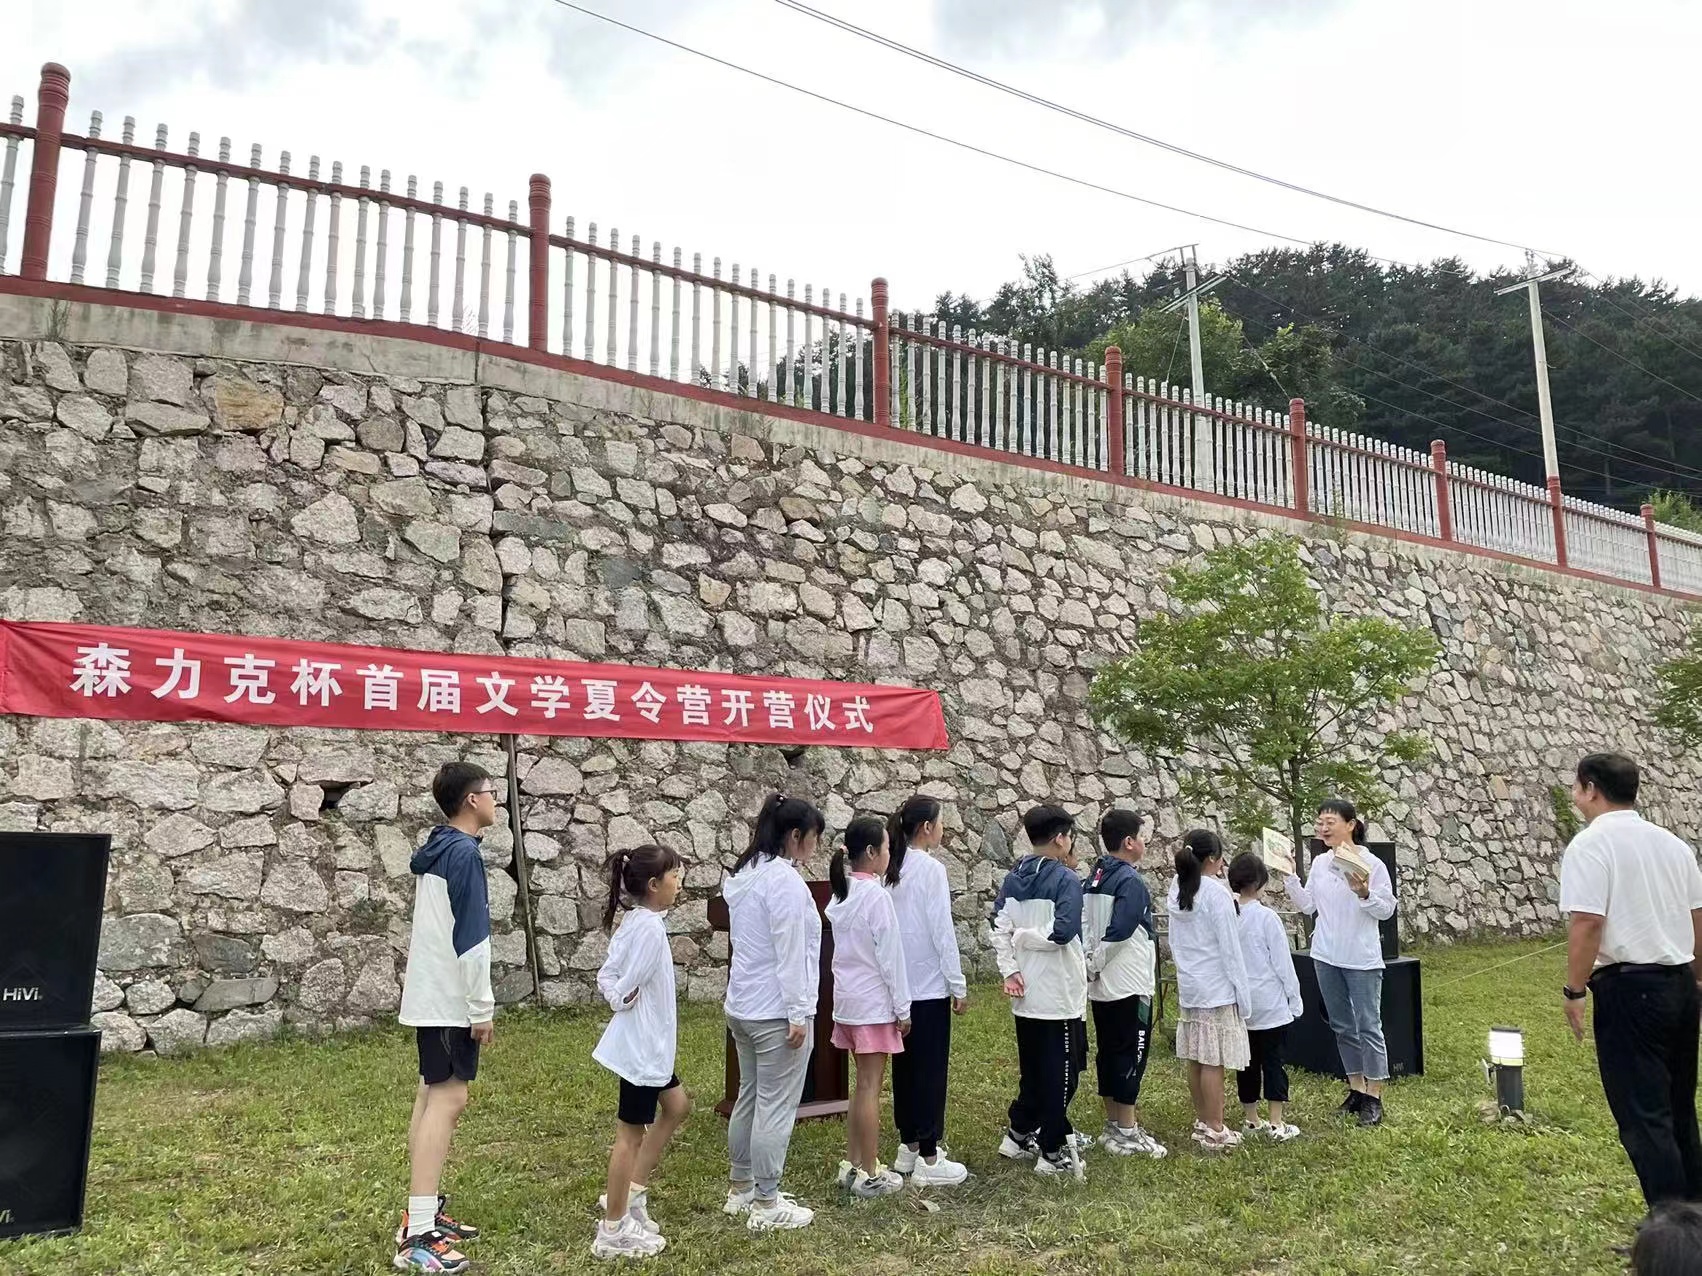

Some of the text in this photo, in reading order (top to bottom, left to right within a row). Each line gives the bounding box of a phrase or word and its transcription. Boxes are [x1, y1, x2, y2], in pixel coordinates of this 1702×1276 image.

[69, 642, 874, 733] 森力克杯首届文学夏令营开营仪式
[3, 987, 39, 1001] HiVi
